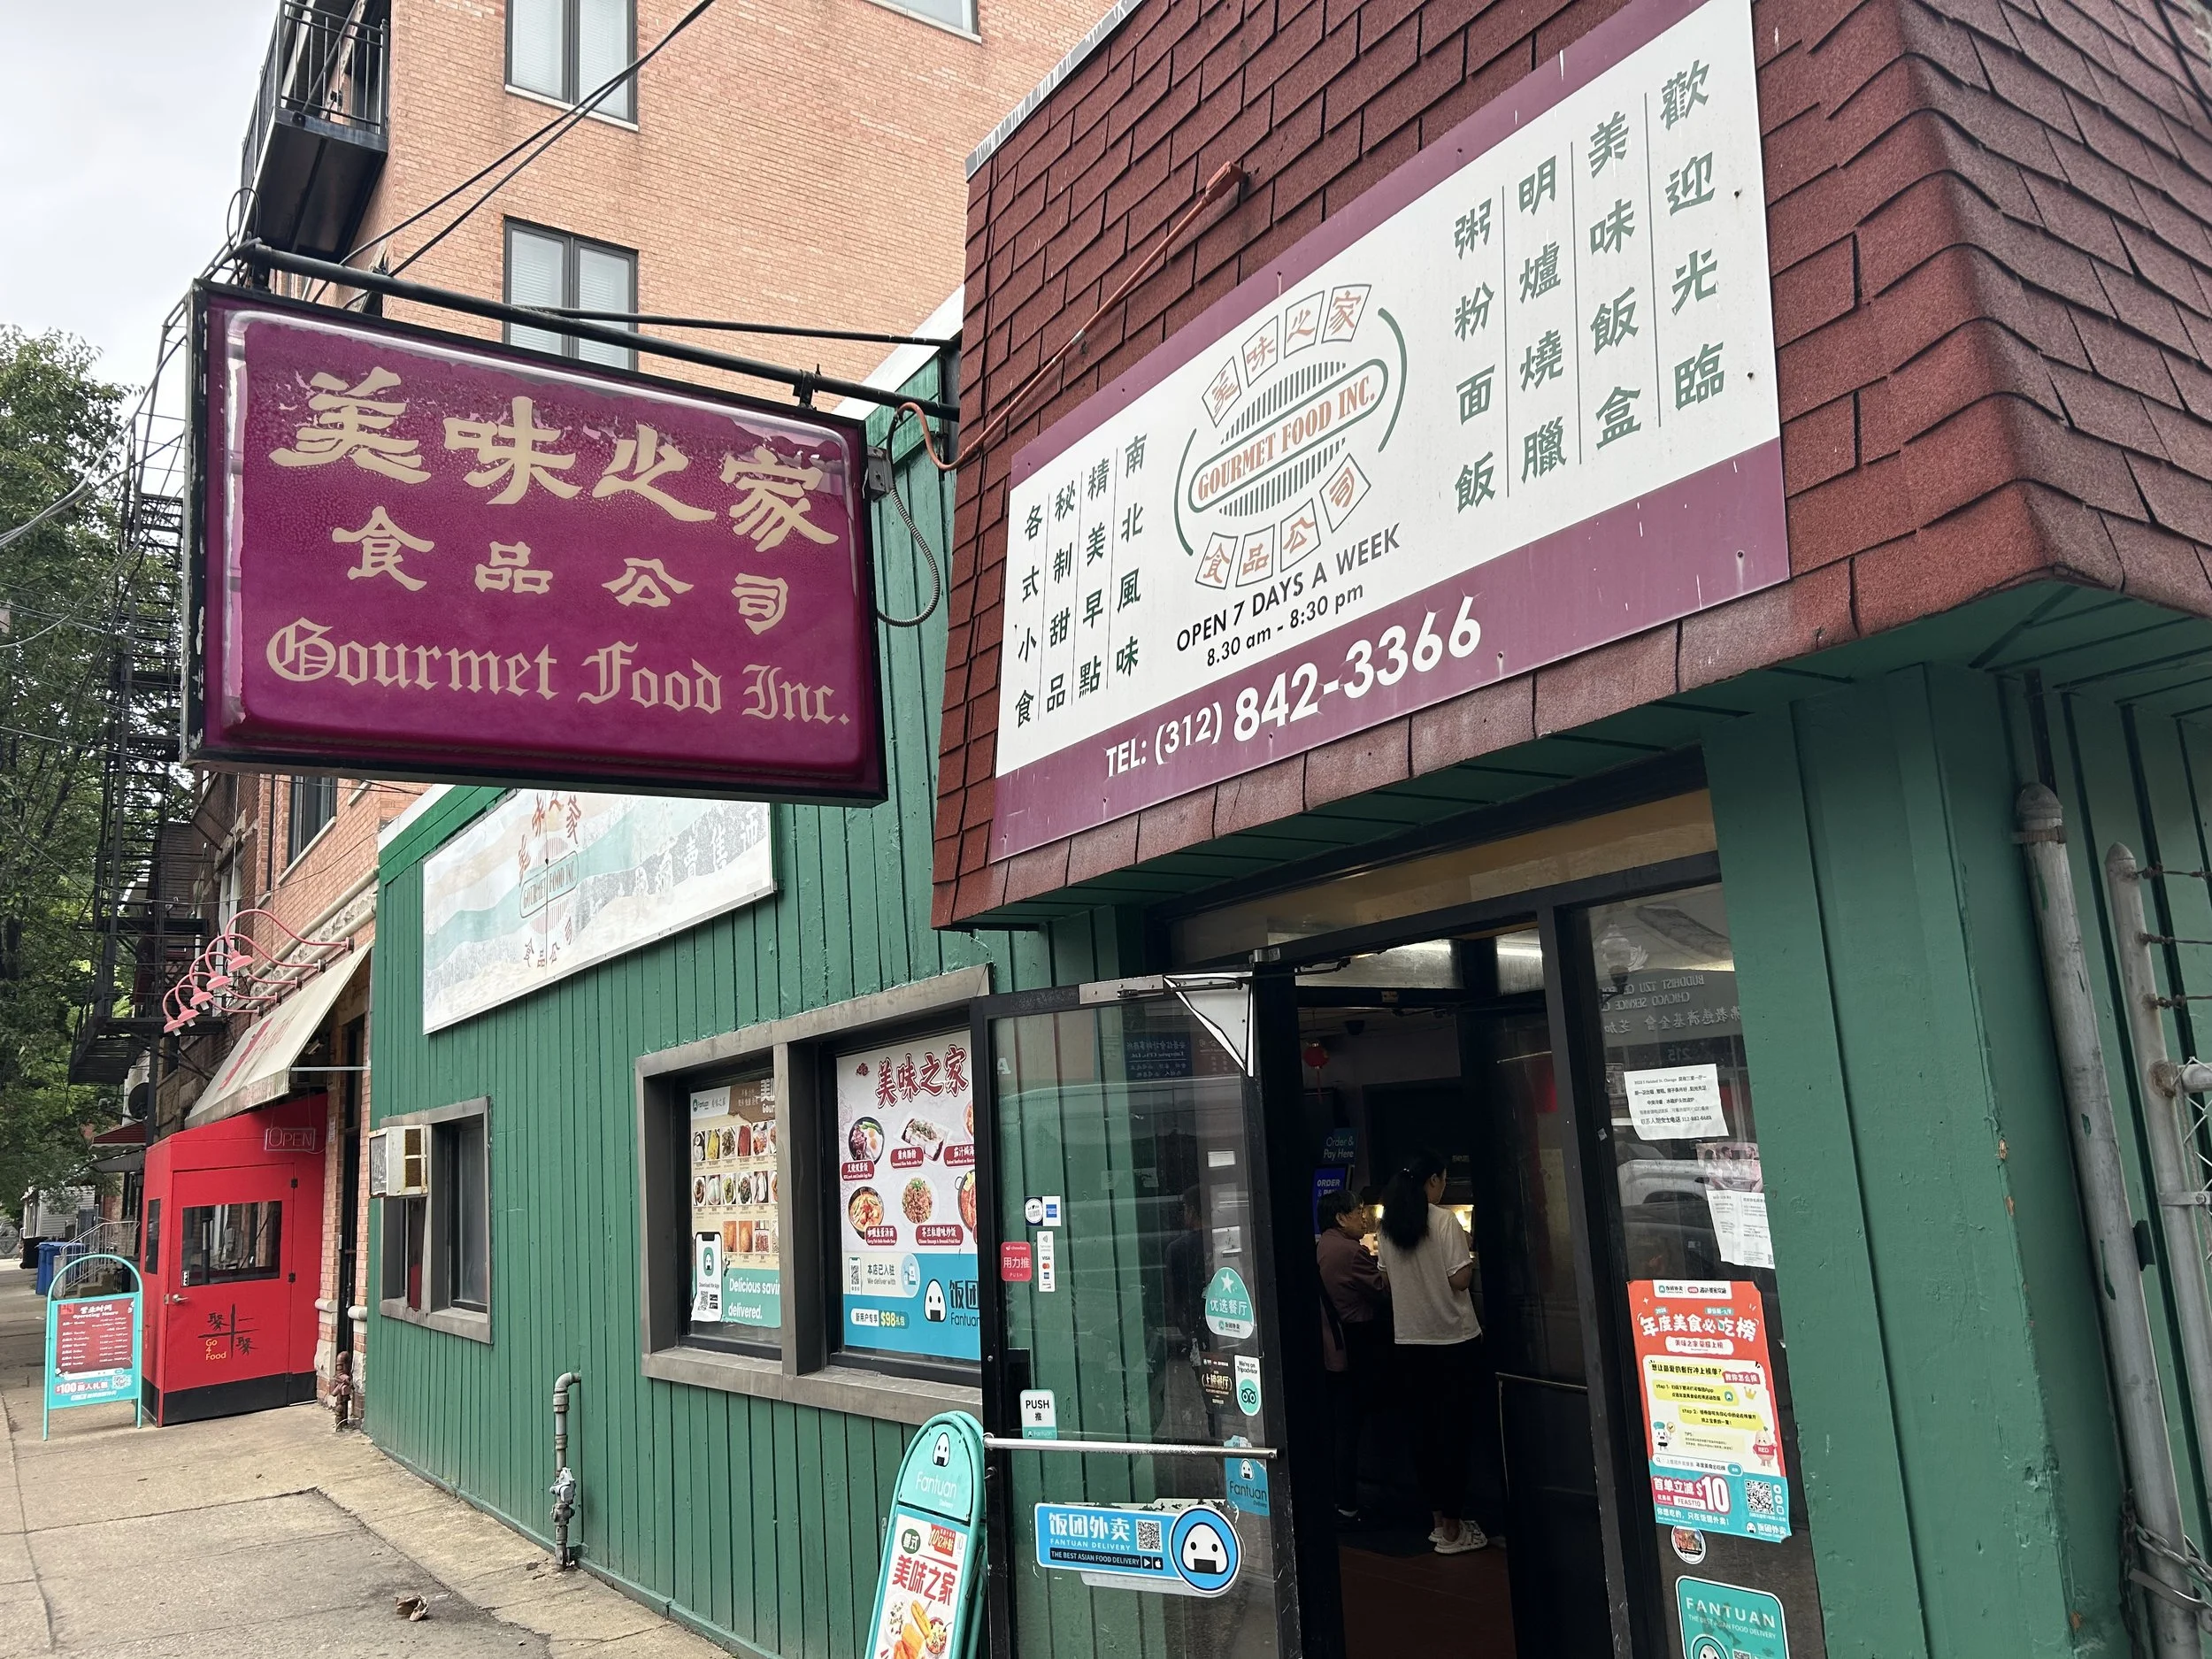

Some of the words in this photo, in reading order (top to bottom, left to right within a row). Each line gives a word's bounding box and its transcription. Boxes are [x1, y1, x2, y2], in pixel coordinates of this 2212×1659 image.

[1660, 59, 1725, 411] 歡迎光臨
[1587, 111, 1641, 450] 美味飯盒
[1518, 155, 1567, 483] 明爐燒臘
[1211, 289, 1363, 423] 美味之家
[1454, 198, 1495, 514] 粥粉面飯
[1197, 432, 1277, 502] GOURMET
[1282, 400, 1332, 455] FOOD
[1337, 375, 1375, 421] INC.
[269, 366, 839, 552] 美味之家
[1202, 466, 1356, 584] 食品公司
[332, 506, 789, 635] 食品公司
[1116, 434, 1148, 678] 南北風味
[1078, 457, 1110, 696] 精美早點
[1177, 610, 1226, 651] OPEN
[1232, 601, 1246, 626] 7
[1252, 571, 1304, 618] DAYS
[1311, 563, 1328, 588] A
[1337, 523, 1401, 575] WEEK
[1046, 482, 1076, 712] 秘制甜品
[1014, 503, 1043, 728] 各式小食
[1207, 635, 1240, 668] 8.30
[1246, 627, 1272, 650] am
[1289, 595, 1328, 628] 8:30
[1334, 581, 1364, 614] pm
[265, 617, 558, 701] Gourmet
[578, 641, 722, 715] Food
[742, 664, 850, 725] Inc.
[1106, 738, 1148, 779] TEL:
[1155, 700, 1224, 765] (312)
[1233, 595, 1482, 742] 842-3366
[548, 865, 565, 894] FOOD
[875, 1043, 970, 1110] 美味之家
[268, 1126, 312, 1147] OPEN
[1326, 1135, 1348, 1147] Order
[1348, 1135, 1355, 1146] &
[1324, 1148, 1336, 1161] Pay
[1337, 1148, 1355, 1158] Here
[867, 1263, 895, 1276] 本店已入驻
[1003, 1256, 1031, 1269] 用力推
[729, 1278, 761, 1293] Delicious
[727, 1302, 763, 1319] delivered.
[856, 1311, 878, 1324] 新用户专享
[880, 1311, 896, 1328] $98
[1210, 1298, 1248, 1317] 优选餐厅
[1640, 1313, 1757, 1342] 年度美食必吃榜
[205, 1338, 218, 1347] Go
[205, 1350, 227, 1361] Food
[1237, 1365, 1258, 1375] Tripadvisor
[1239, 1360, 1249, 1369] We're
[1025, 1400, 1049, 1409] PUSH
[1034, 1412, 1042, 1422] 推
[915, 1471, 957, 1499] Fantuan
[1229, 1480, 1267, 1502] Fantuan
[1653, 1477, 1694, 1495] 首单立减
[1695, 1476, 1730, 1513] $10
[1048, 1512, 1131, 1542] 饭团外卖
[1757, 1522, 1786, 1536] 饭团外卖
[1049, 1538, 1088, 1548] FANTUAN
[1091, 1542, 1131, 1551] DELIVERY
[1078, 1553, 1094, 1562] ASIAN
[1112, 1556, 1140, 1566] DELIVERY
[892, 1555, 956, 1606] 美味之家
[1686, 1596, 1776, 1628] FANTUAN
[1732, 1624, 1749, 1633] FOOD
[1749, 1625, 1777, 1640] DELIVERY
